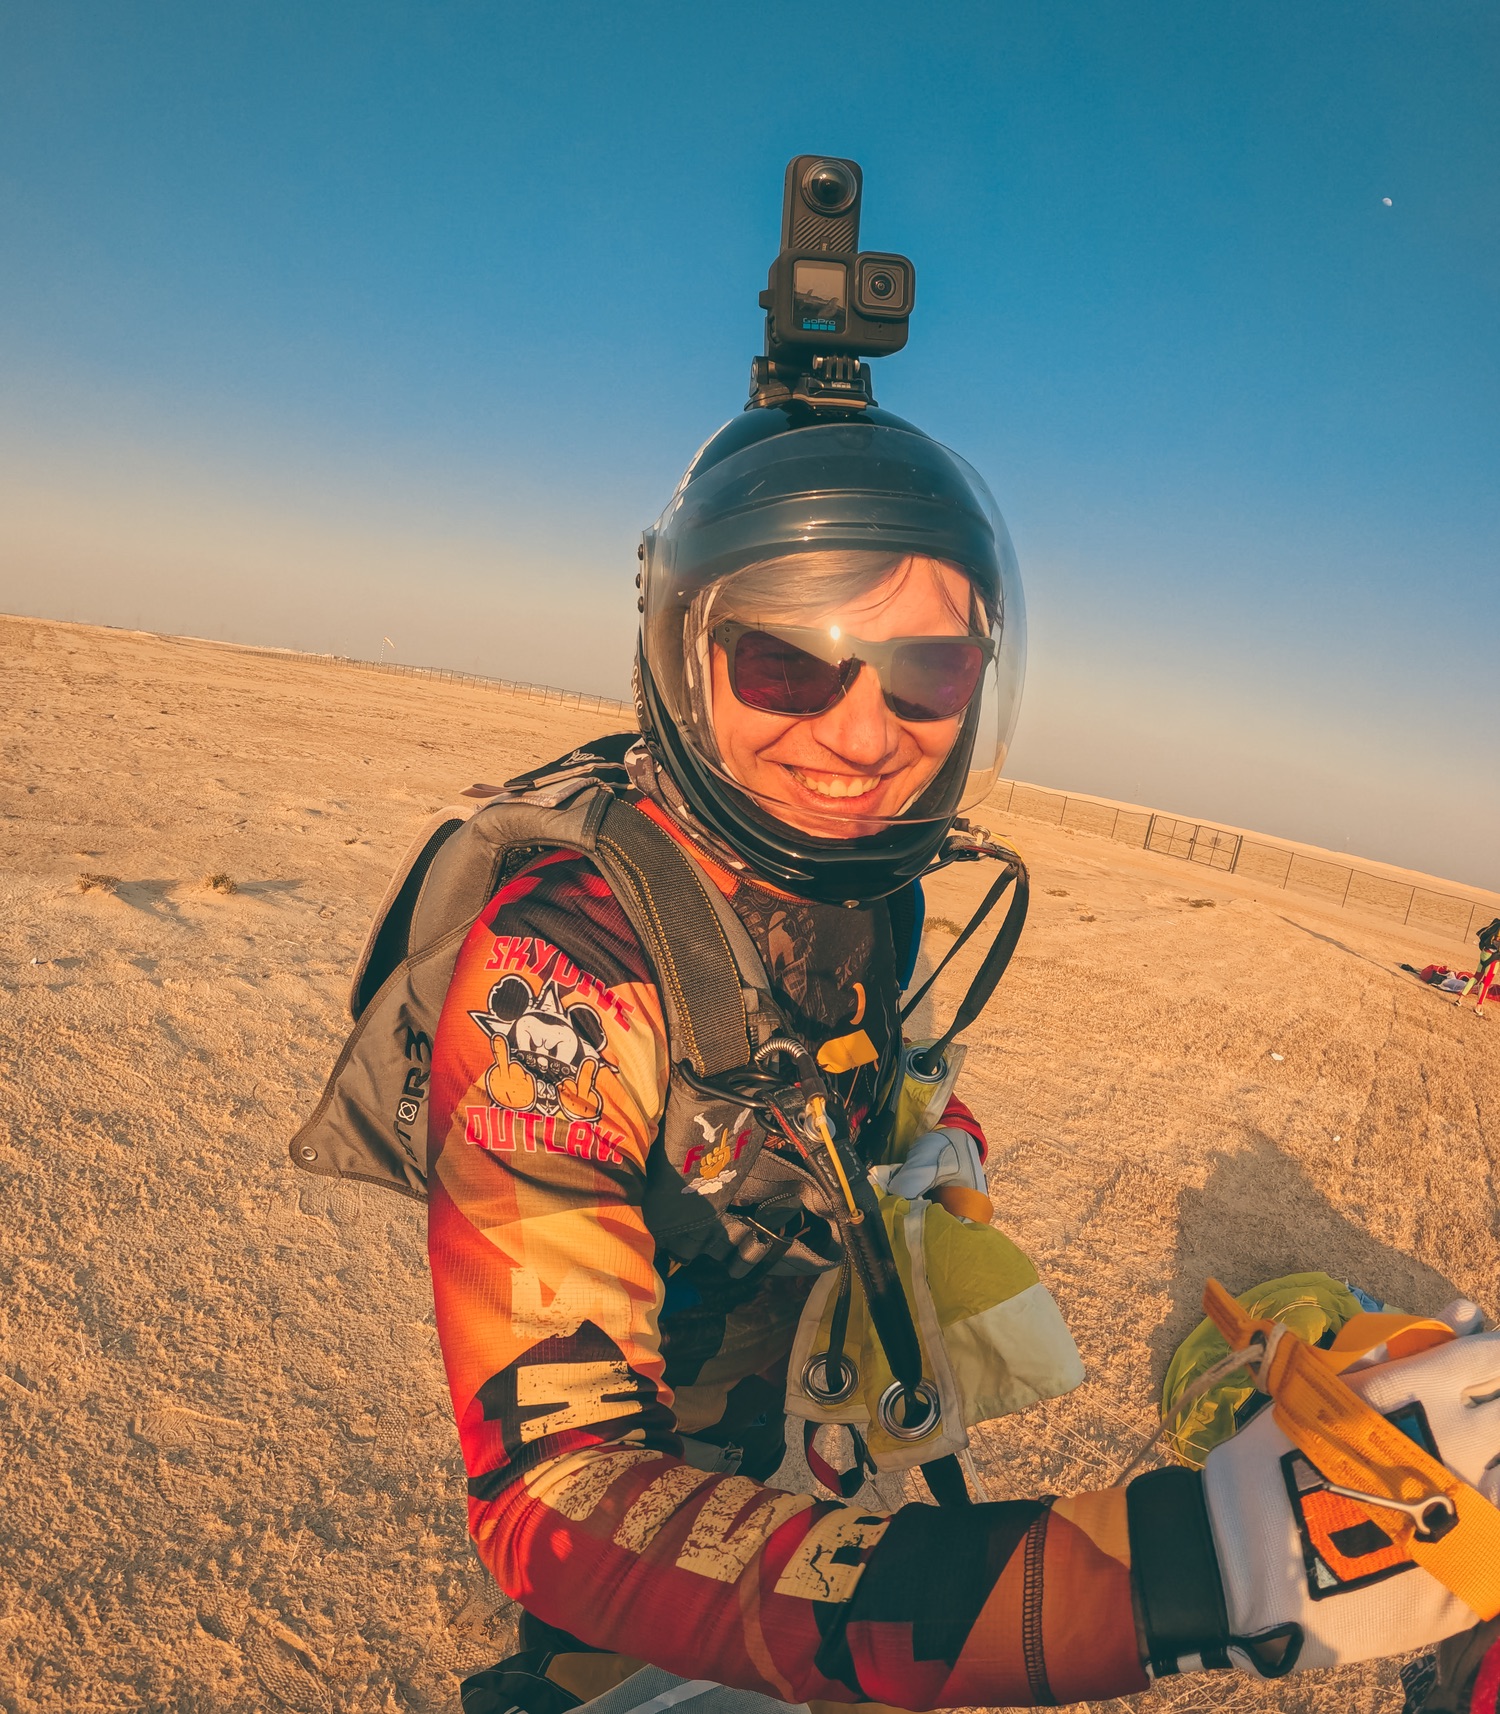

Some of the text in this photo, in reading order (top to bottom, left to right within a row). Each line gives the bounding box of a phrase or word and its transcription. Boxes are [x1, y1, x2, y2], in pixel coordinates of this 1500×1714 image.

[802, 317, 836, 325] GoPro
[484, 936, 636, 1032] SKYDIVE
[465, 1105, 627, 1165] OUTLAW
